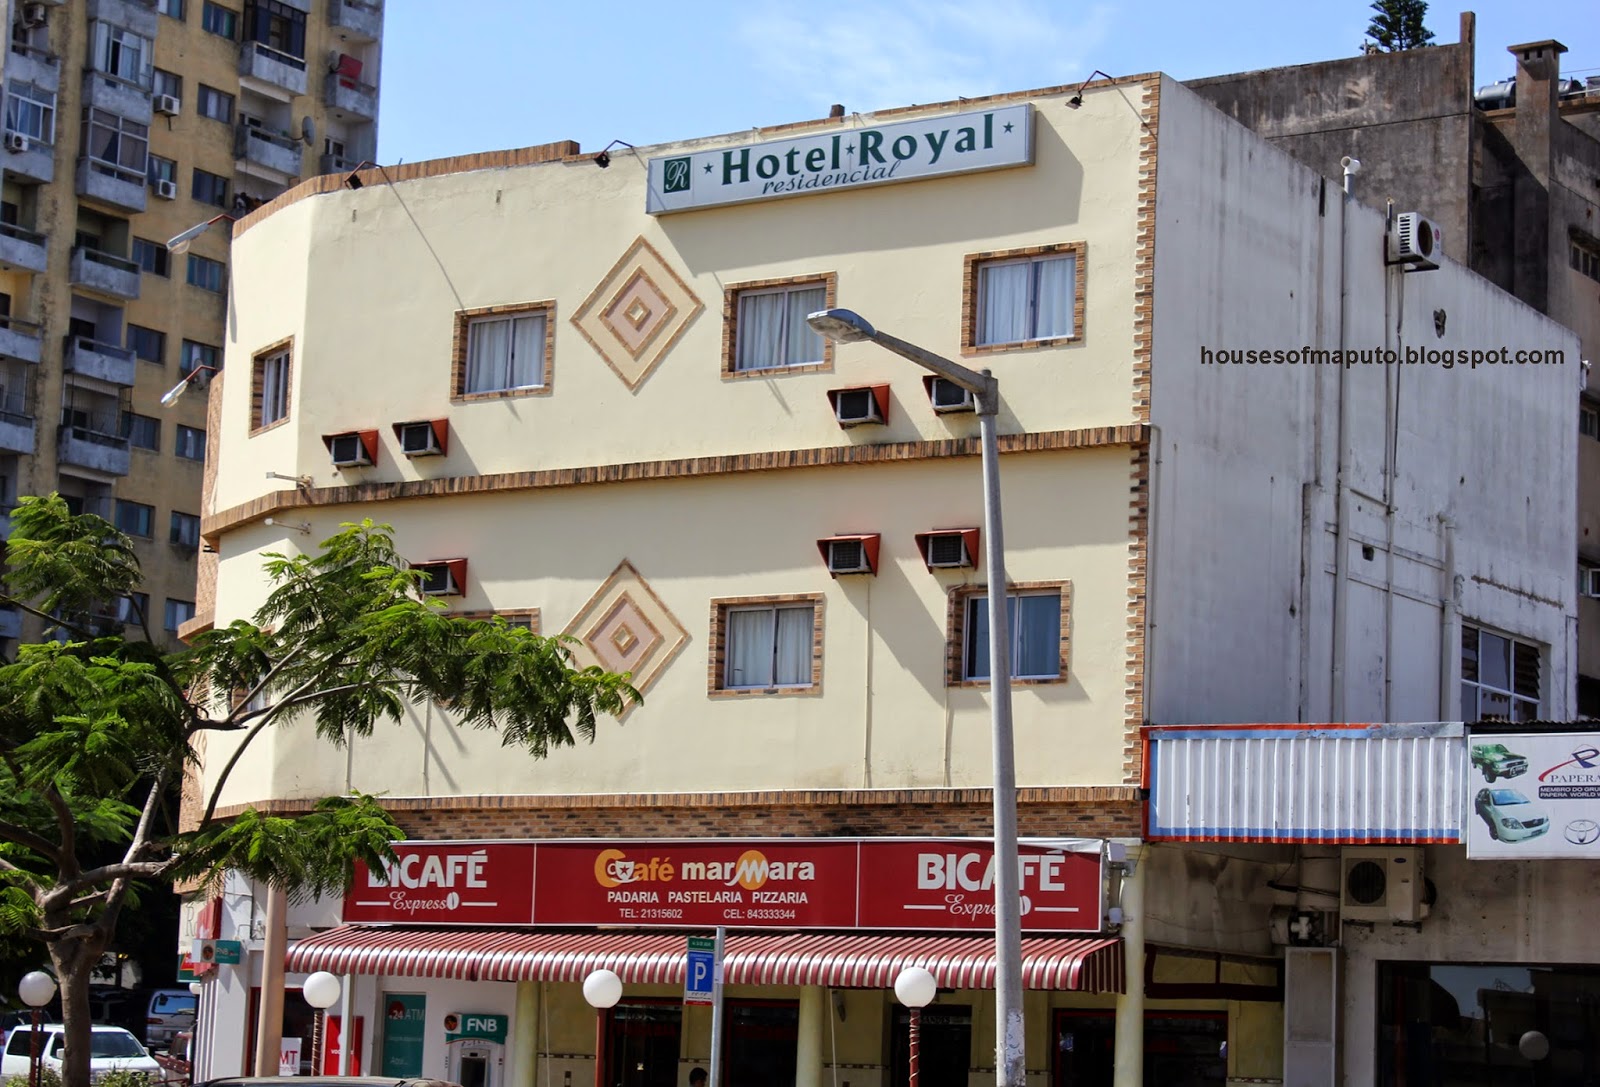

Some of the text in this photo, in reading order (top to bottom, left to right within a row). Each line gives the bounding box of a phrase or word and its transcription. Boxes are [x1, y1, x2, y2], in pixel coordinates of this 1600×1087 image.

[722, 113, 995, 186] Hotel Royal
[762, 158, 902, 195] residencial
[594, 848, 675, 888] Café
[607, 891, 808, 904] PADARIA PASTELARIA PIZZARIA
[619, 908, 683, 919] TEL: 21315602
[723, 909, 796, 920] CEL: 843333344
[694, 961, 707, 990] P
[466, 1018, 498, 1032] FNB
